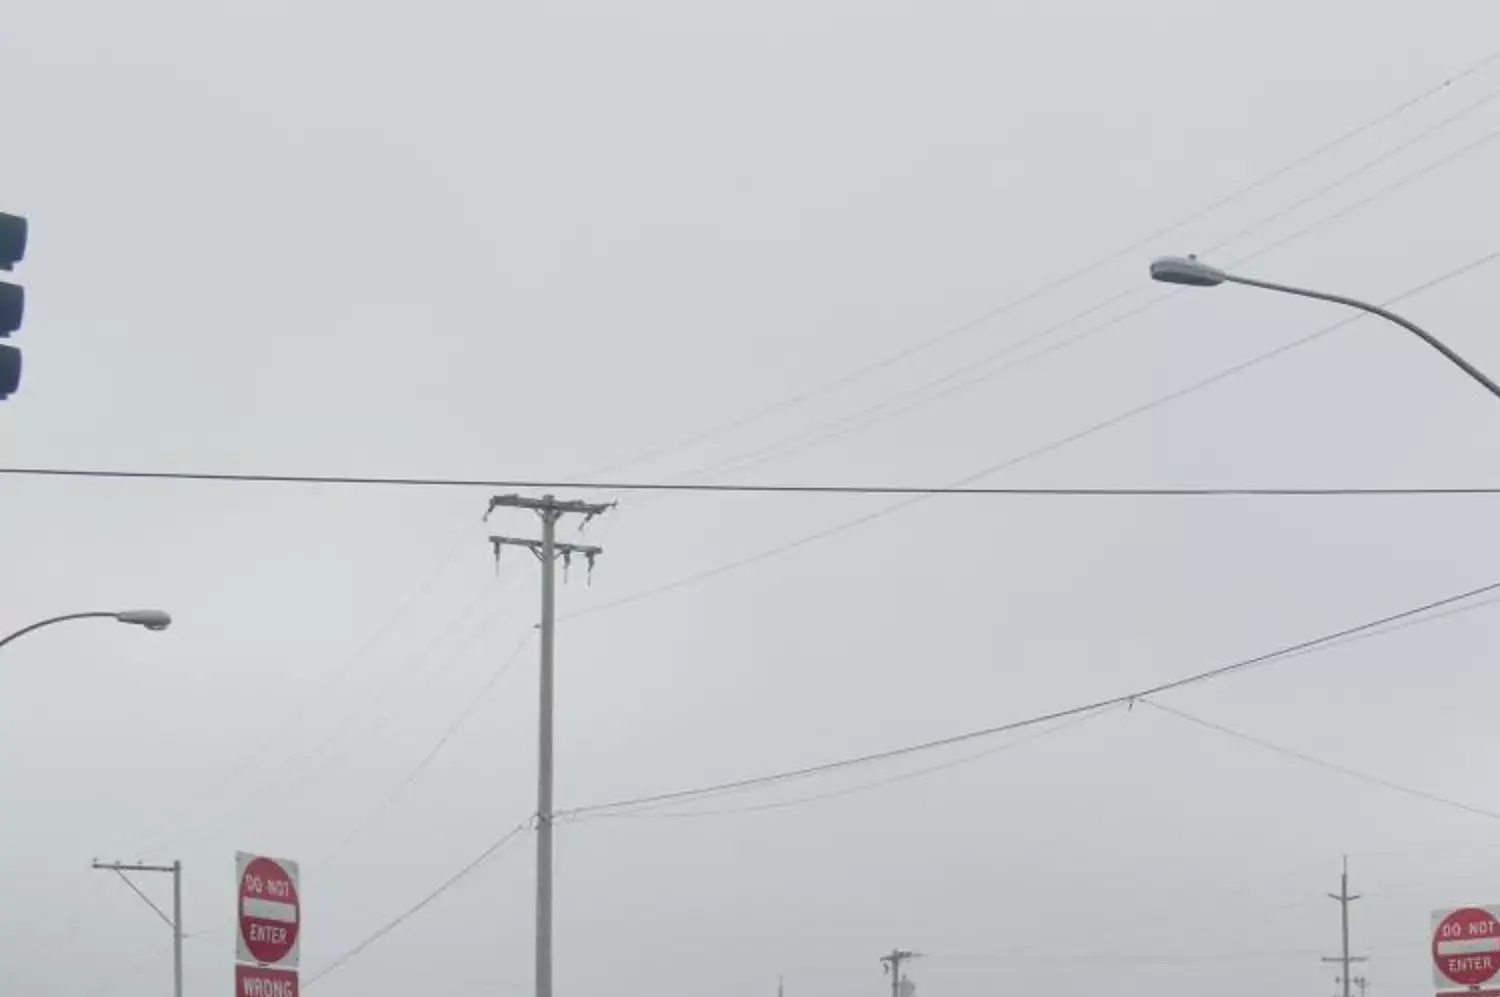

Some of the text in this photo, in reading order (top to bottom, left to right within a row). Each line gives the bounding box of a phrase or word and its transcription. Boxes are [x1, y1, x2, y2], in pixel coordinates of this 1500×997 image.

[245, 874, 290, 898] DO NOT
[249, 923, 287, 945] ENTER
[1442, 920, 1495, 938] DO NOT
[1447, 957, 1493, 973] ENTER
